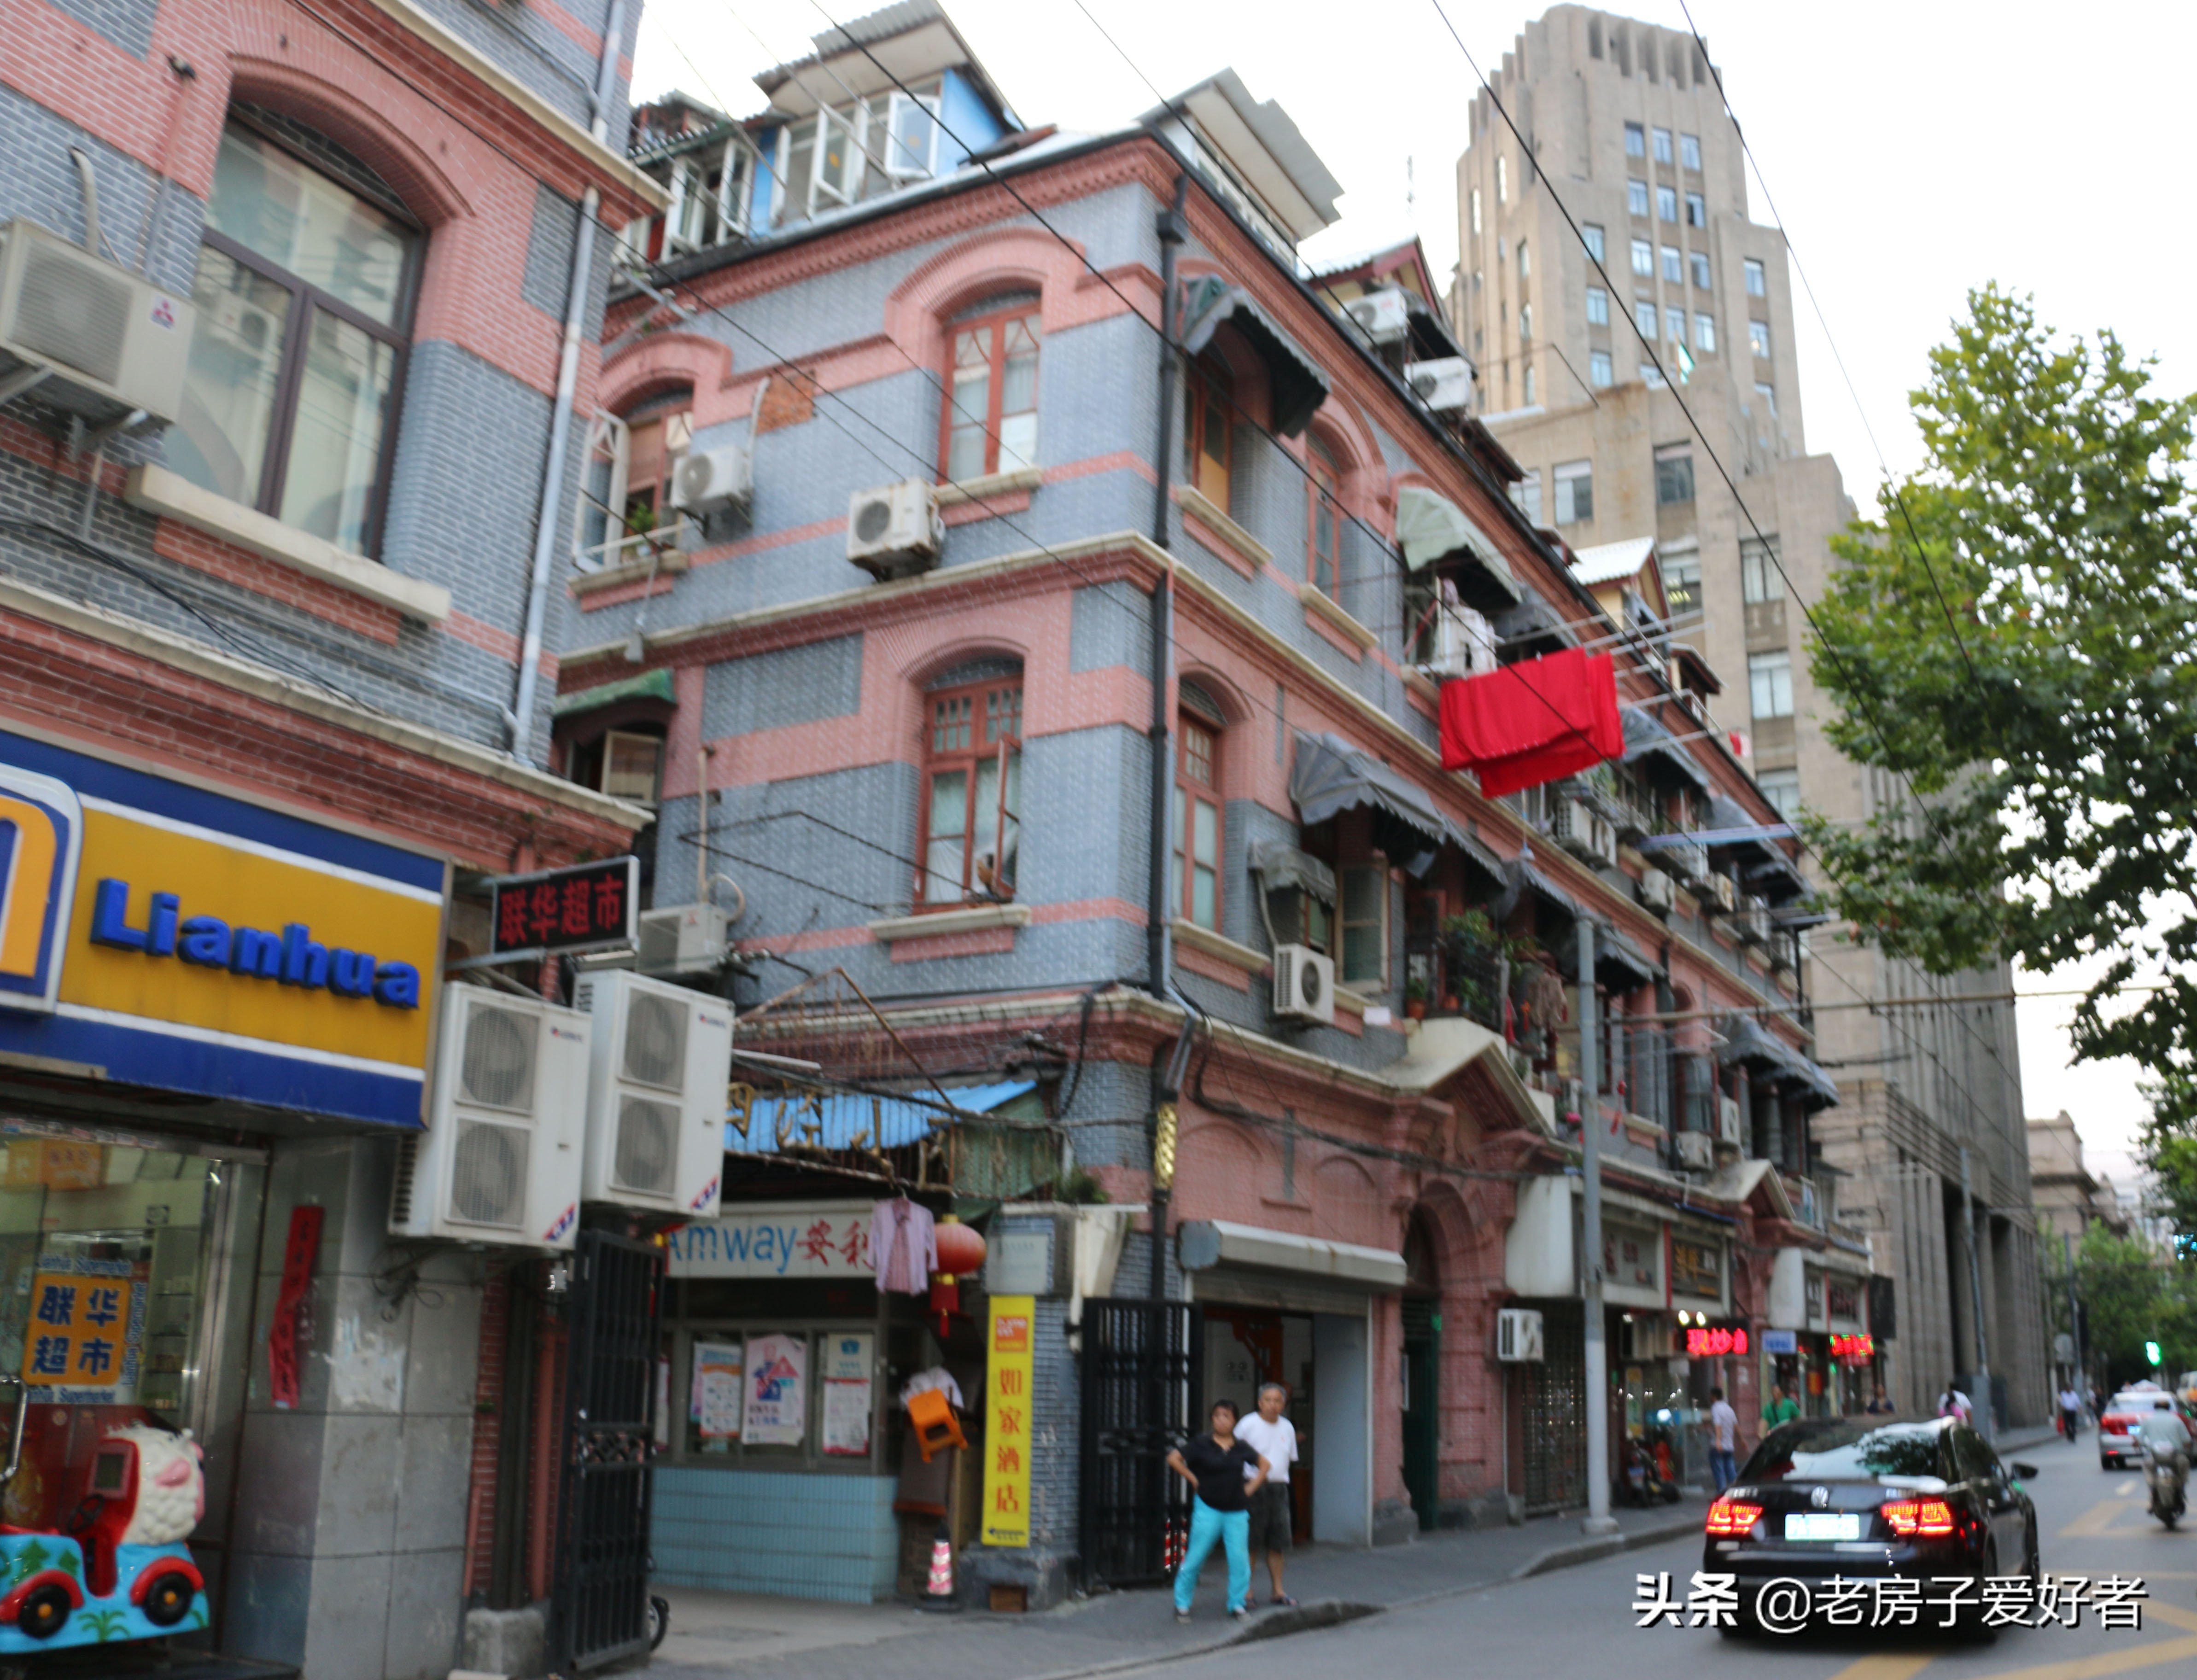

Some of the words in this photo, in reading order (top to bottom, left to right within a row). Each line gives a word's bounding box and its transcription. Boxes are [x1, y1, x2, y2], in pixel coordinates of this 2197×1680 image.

[90, 878, 421, 1010] Lianhua
[499, 873, 624, 946] 联华超市
[996, 1368, 1022, 1513] 如家酒店
